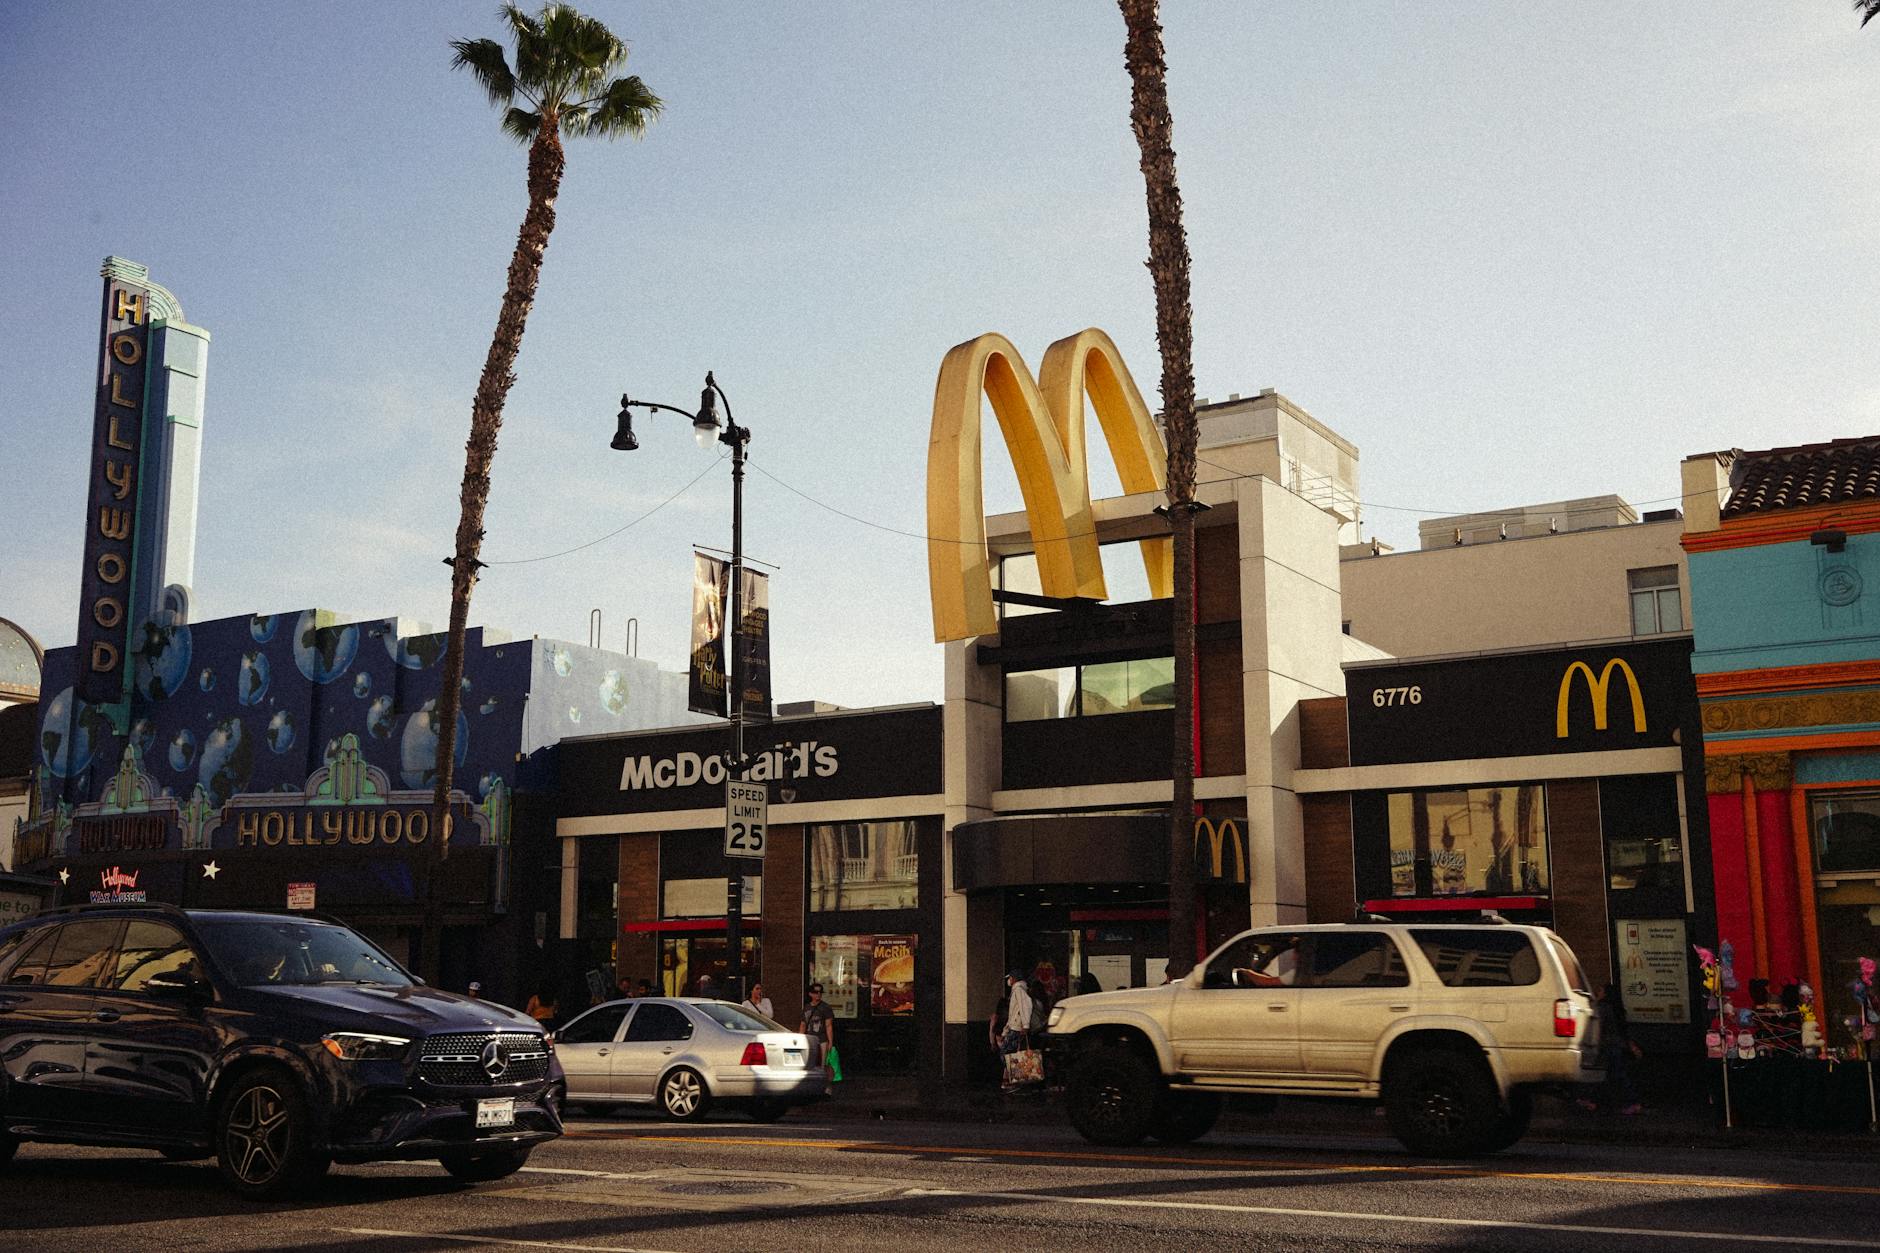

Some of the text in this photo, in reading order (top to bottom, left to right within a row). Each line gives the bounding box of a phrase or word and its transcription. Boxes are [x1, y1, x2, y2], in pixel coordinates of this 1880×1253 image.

[91, 288, 143, 673] HOLLYWOOD
[1372, 685, 1423, 707] 6776
[730, 788, 764, 802] SPEED
[734, 805, 761, 819] LIMIT
[729, 822, 763, 851] 25
[101, 866, 139, 894] Hollywood
[90, 890, 147, 904] WAX MUSEUM
[15, 900, 31, 914] to
